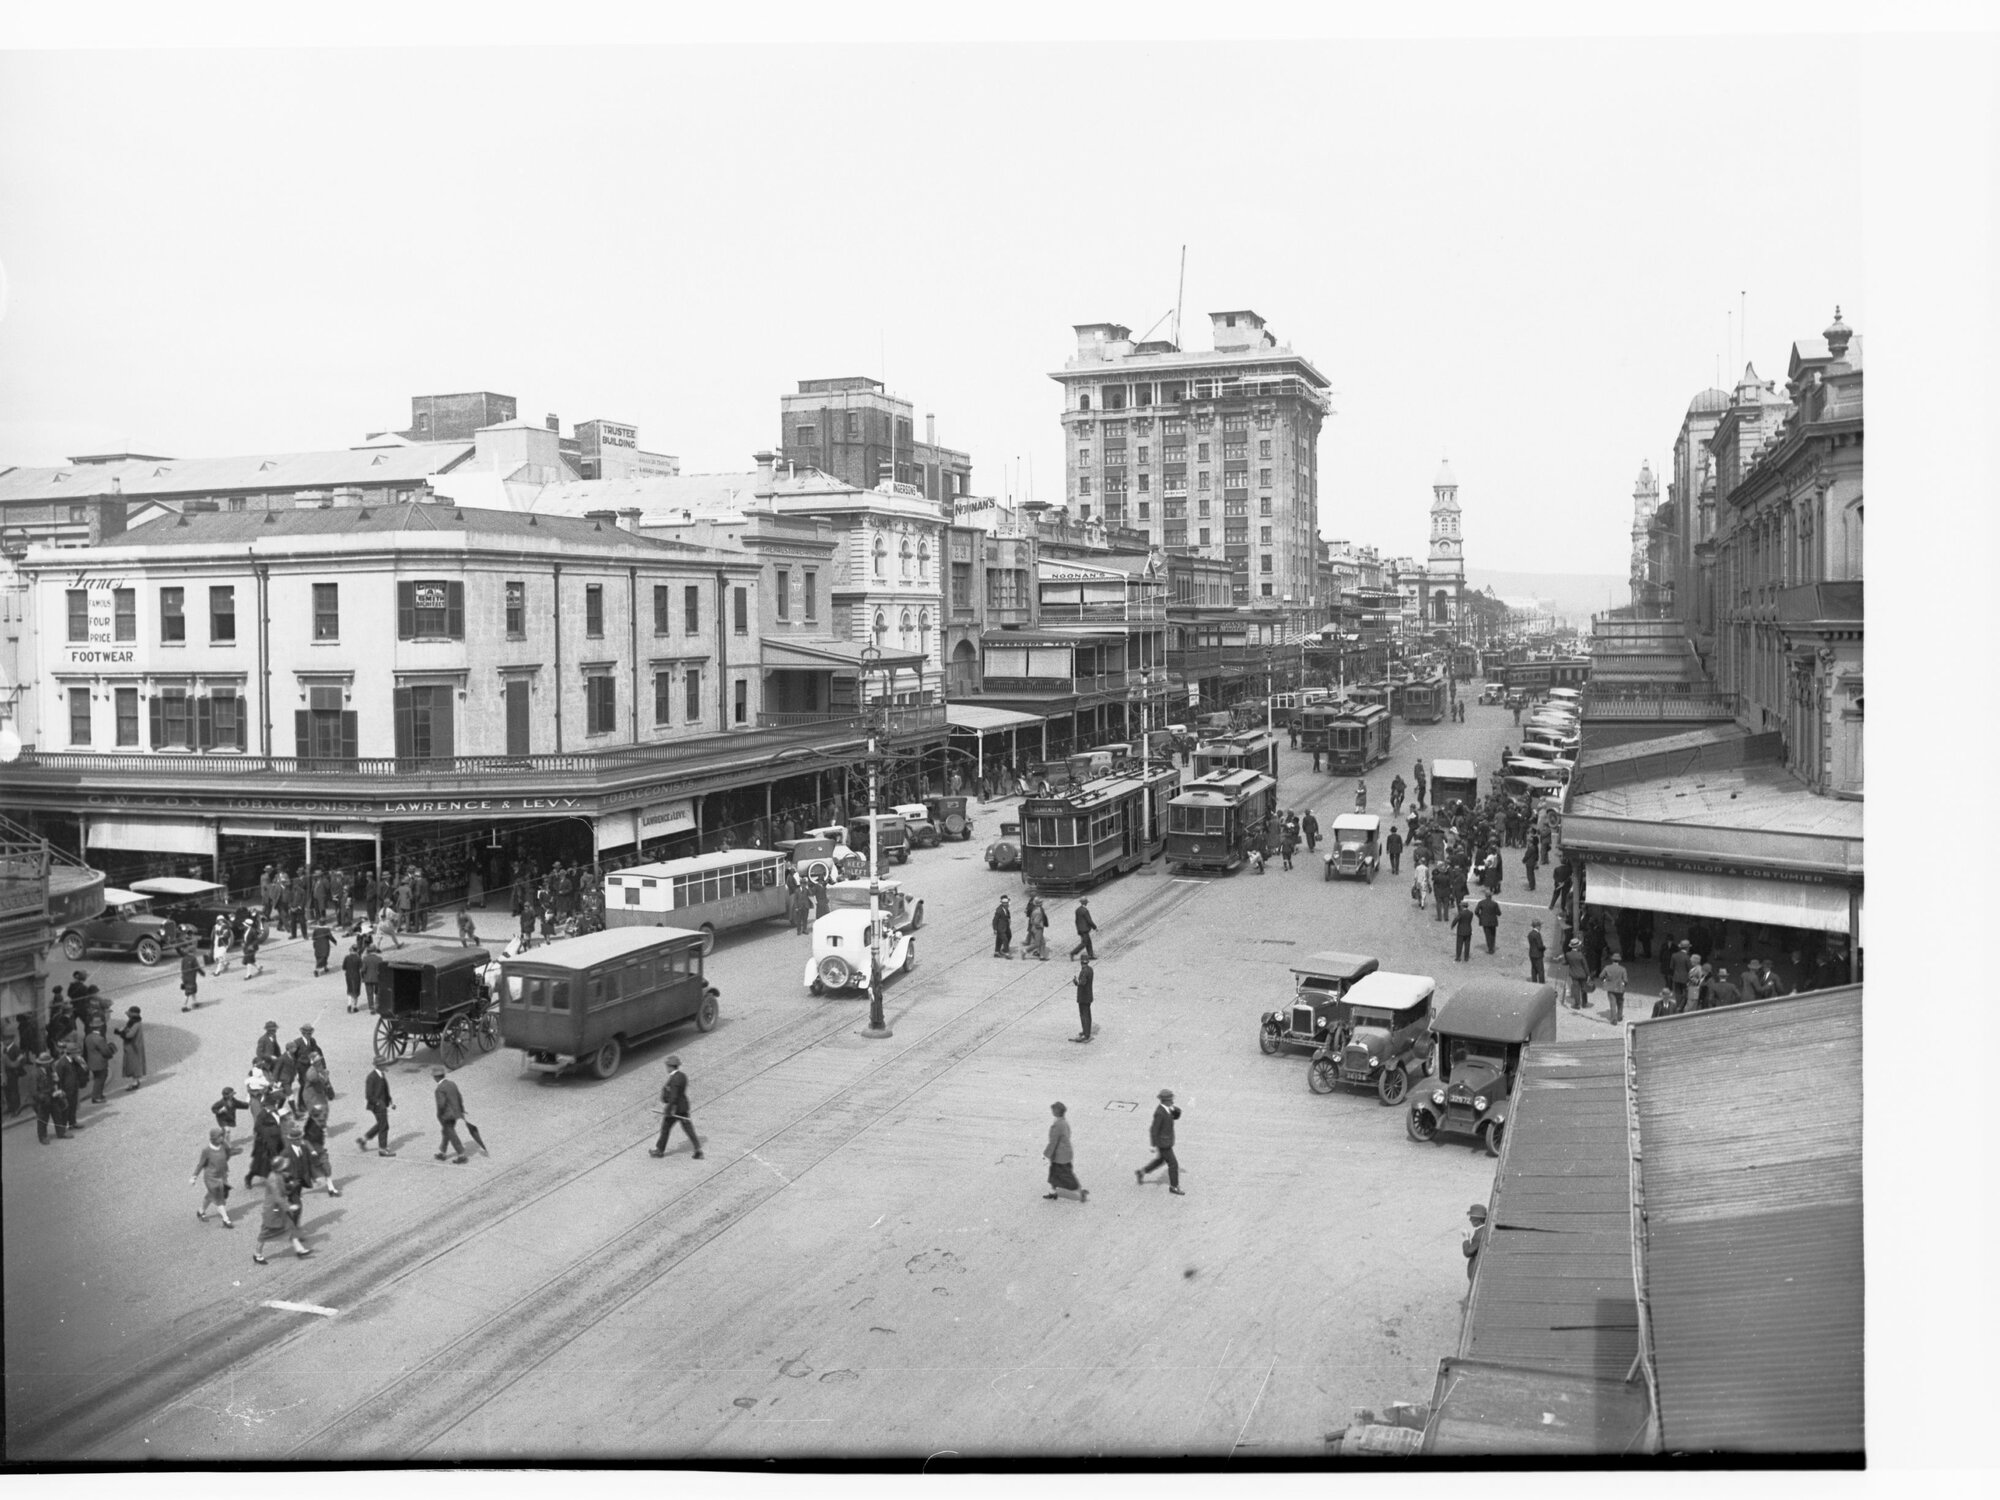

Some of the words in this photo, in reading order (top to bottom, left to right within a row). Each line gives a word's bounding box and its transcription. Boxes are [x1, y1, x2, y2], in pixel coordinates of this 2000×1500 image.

[603, 425, 636, 438] TRUSTEE
[89, 617, 110, 626] FOUR
[90, 633, 111, 642] PRICE
[227, 799, 373, 812] TOBACCONISTS
[385, 801, 493, 812] LAWRENCE
[642, 814, 671, 827] LAWRENCE
[851, 868, 867, 876] LEFT
[1676, 862, 1722, 873] TAILOR
[1743, 869, 1823, 883] COSTUMIER
